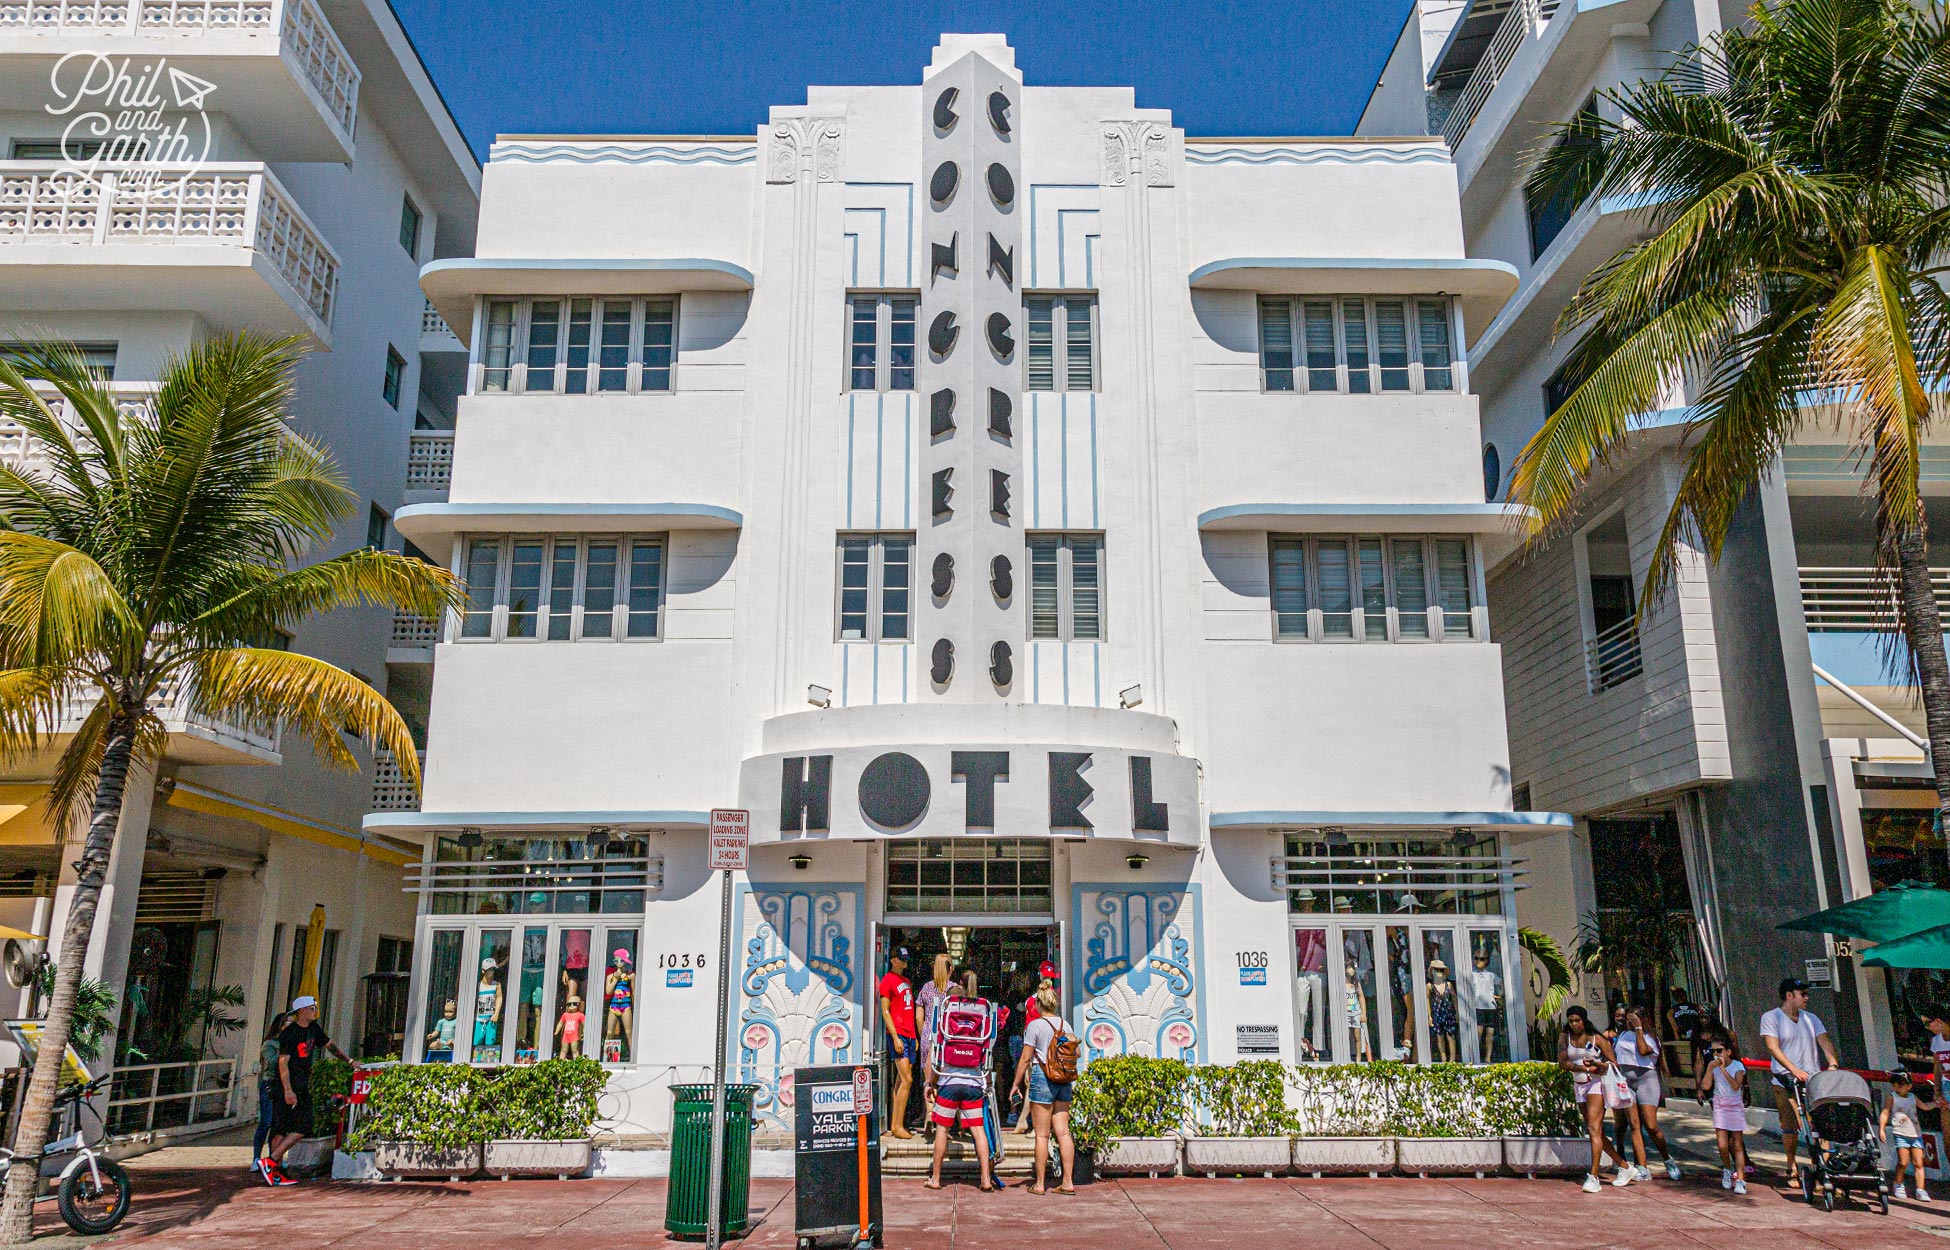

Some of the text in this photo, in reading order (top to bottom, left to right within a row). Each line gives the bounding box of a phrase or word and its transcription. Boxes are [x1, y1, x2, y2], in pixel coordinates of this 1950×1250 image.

[929, 86, 961, 685] CONGRESS
[985, 90, 1015, 687] CONGRESS
[780, 750, 1169, 831] HOTEL
[716, 813, 744, 822] PASSENGER
[713, 825, 746, 835] LOADING ZONE
[713, 838, 746, 848] VALET PARKING
[725, 850, 739, 860] HOURS
[659, 953, 706, 968] 1036
[1235, 951, 1268, 967] 1036
[1236, 1025, 1279, 1033] NO TRESPASSING
[813, 1089, 854, 1105] CONGRE
